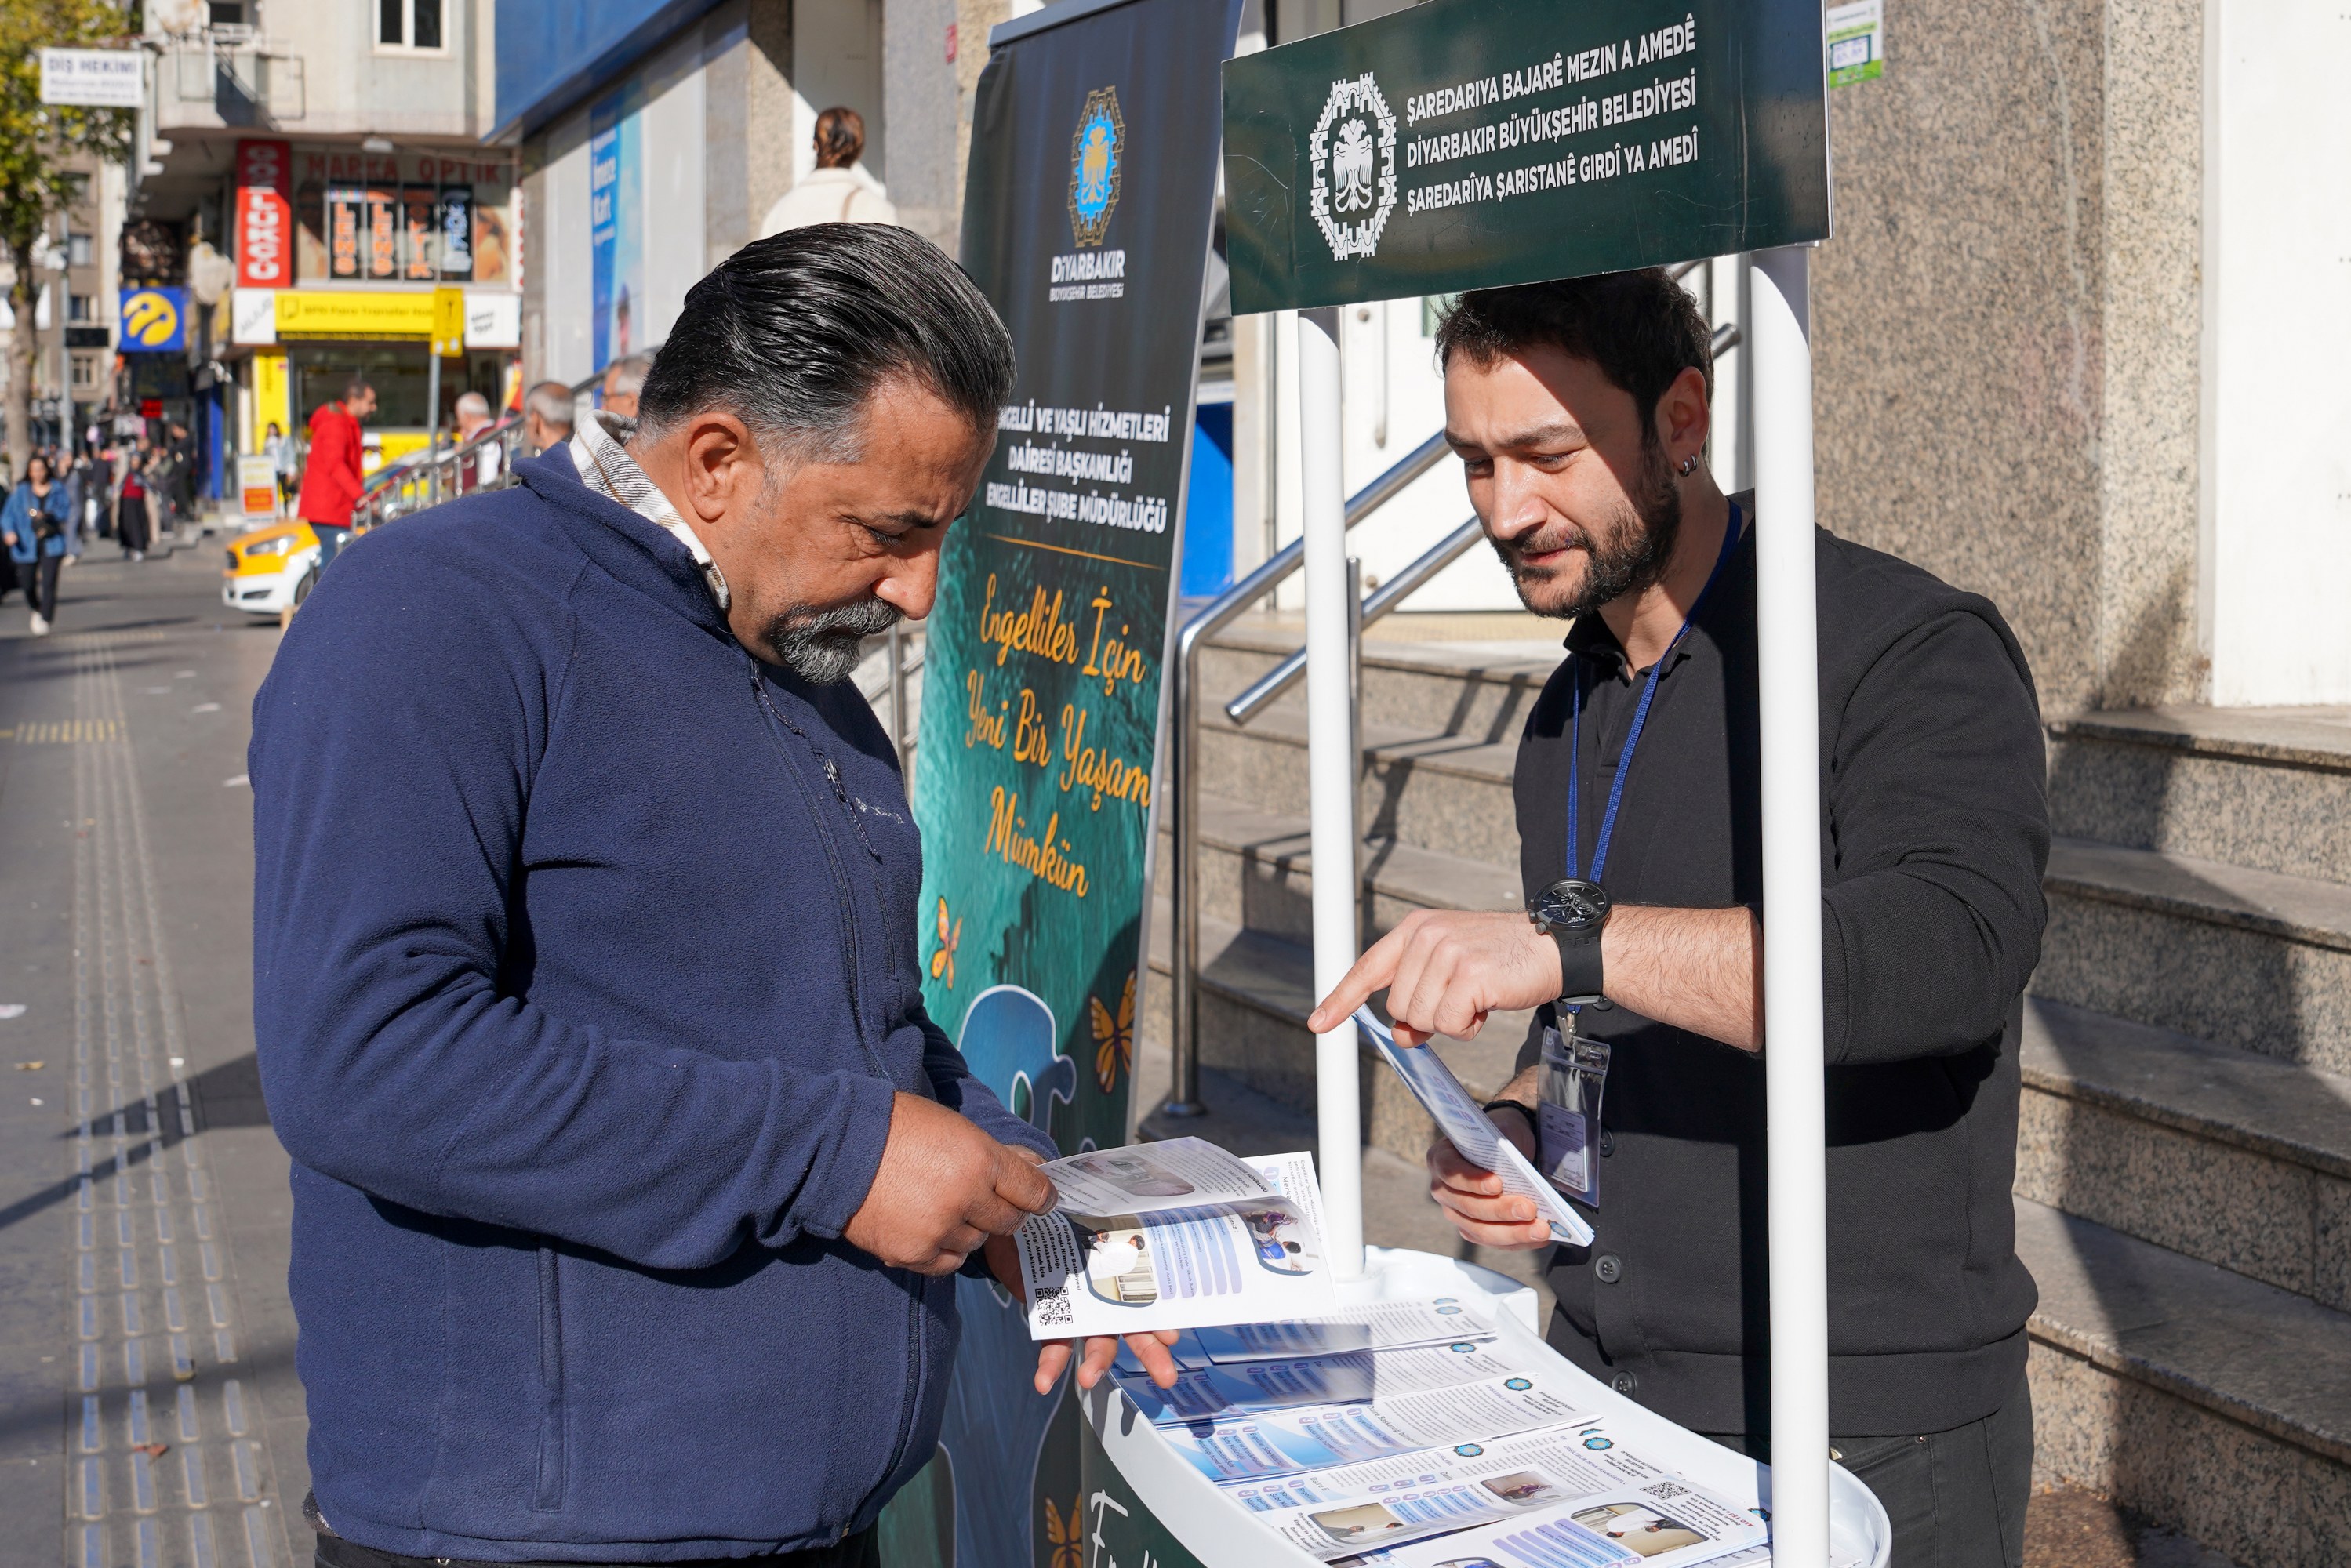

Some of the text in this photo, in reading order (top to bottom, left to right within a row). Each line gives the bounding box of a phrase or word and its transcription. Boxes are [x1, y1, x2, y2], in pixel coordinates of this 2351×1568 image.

[1407, 13, 1695, 127] ŞAREDARIYA BAJARÊ MEZIN A AMEDÊ
[1408, 68, 1695, 168] DİYARBAKIR BÜYÜKŞEHİR BELEDİYESİ
[307, 154, 398, 180] MARKA
[1408, 125, 1698, 217] ŞAREDARÎYA ŞARISTANÊ GIRDÎ YA AMEDÎ
[334, 202, 357, 275] LENS
[372, 202, 394, 275] LENS
[1036, 407, 1054, 434] VE
[1054, 408, 1088, 442] YAŞLI
[1088, 401, 1171, 443] HİZMETLERİ
[1008, 438, 1133, 485] DAİRESİ BAŞKANLIĞI
[986, 478, 1167, 534] ENGELLİLER ŞUBE MÜDÜRLÜĞÜ
[980, 573, 1145, 696] Engelliler İçin
[966, 669, 1150, 811] Yeni Bir Yaşam
[985, 786, 1090, 898] Mümkün
[1282, 1176, 1292, 1200] Merke
[1025, 1238, 1037, 1283] Arayabilirsiniz
[1041, 1218, 1052, 1237] Dairesi
[1050, 1237, 1060, 1269] Başkanlığı
[1043, 1244, 1052, 1272] Hakkında
[1060, 1247, 1070, 1280] Hizmetleri
[1063, 1219, 1081, 1290] Büyükşehir Belediyesi
